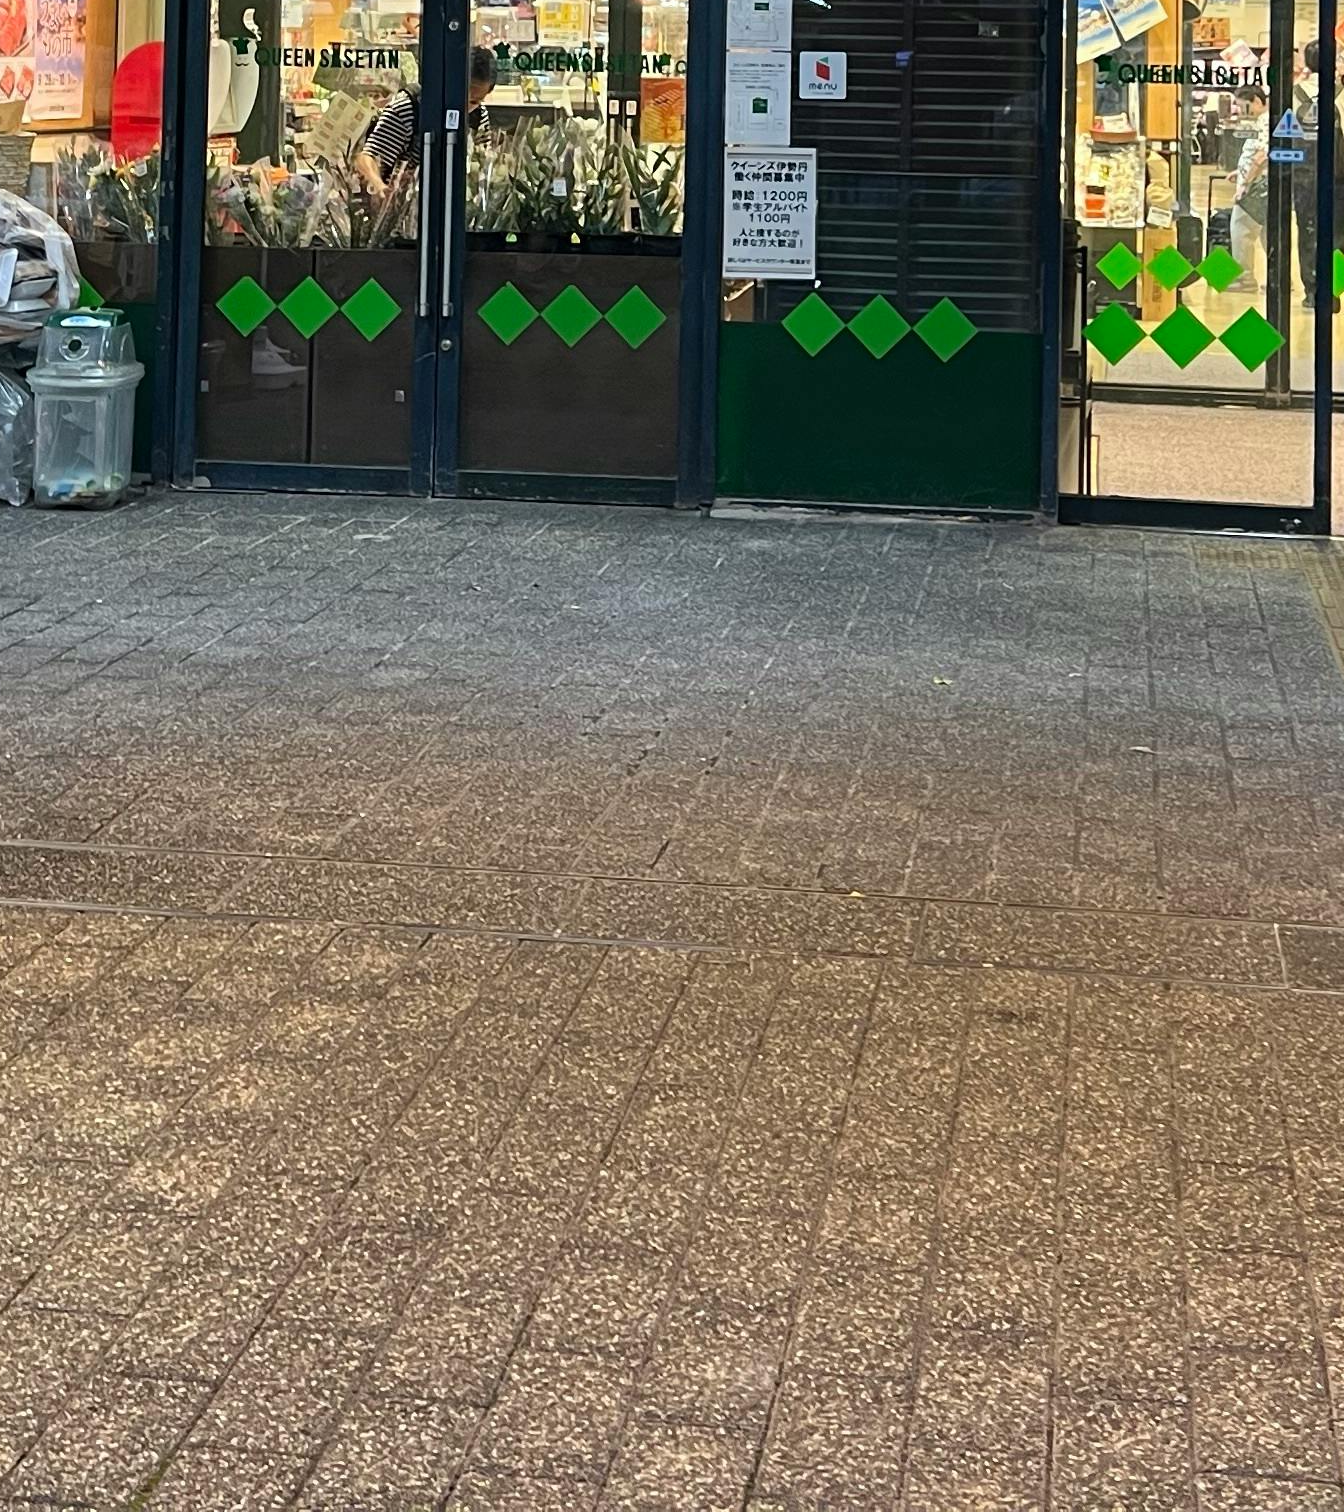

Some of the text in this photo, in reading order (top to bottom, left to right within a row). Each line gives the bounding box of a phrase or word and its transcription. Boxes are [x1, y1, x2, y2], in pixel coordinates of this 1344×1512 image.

[808, 82, 838, 91] menu
[762, 190, 808, 202] 1200円
[749, 213, 791, 224] 1100円
